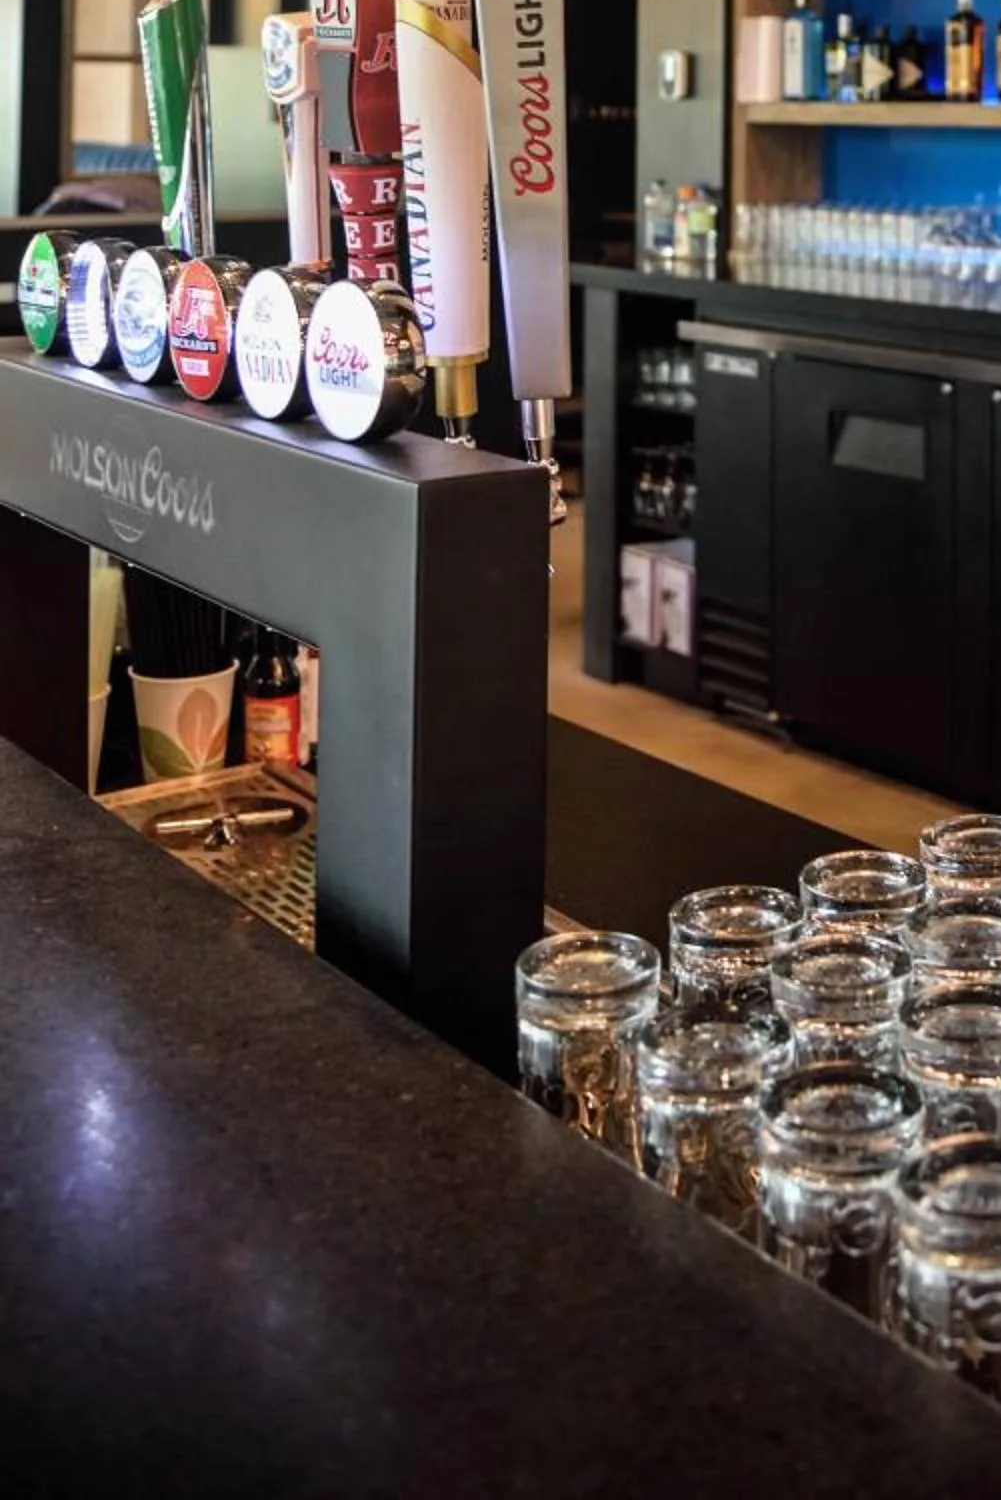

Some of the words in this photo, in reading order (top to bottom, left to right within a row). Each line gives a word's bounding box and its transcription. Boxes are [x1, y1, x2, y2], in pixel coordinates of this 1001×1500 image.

[509, 71, 555, 196] Coors
[400, 122, 435, 332] CANADIAN
[313, 327, 370, 372] Coors
[50, 430, 138, 502] MOLSON
[140, 444, 215, 534] Coors
